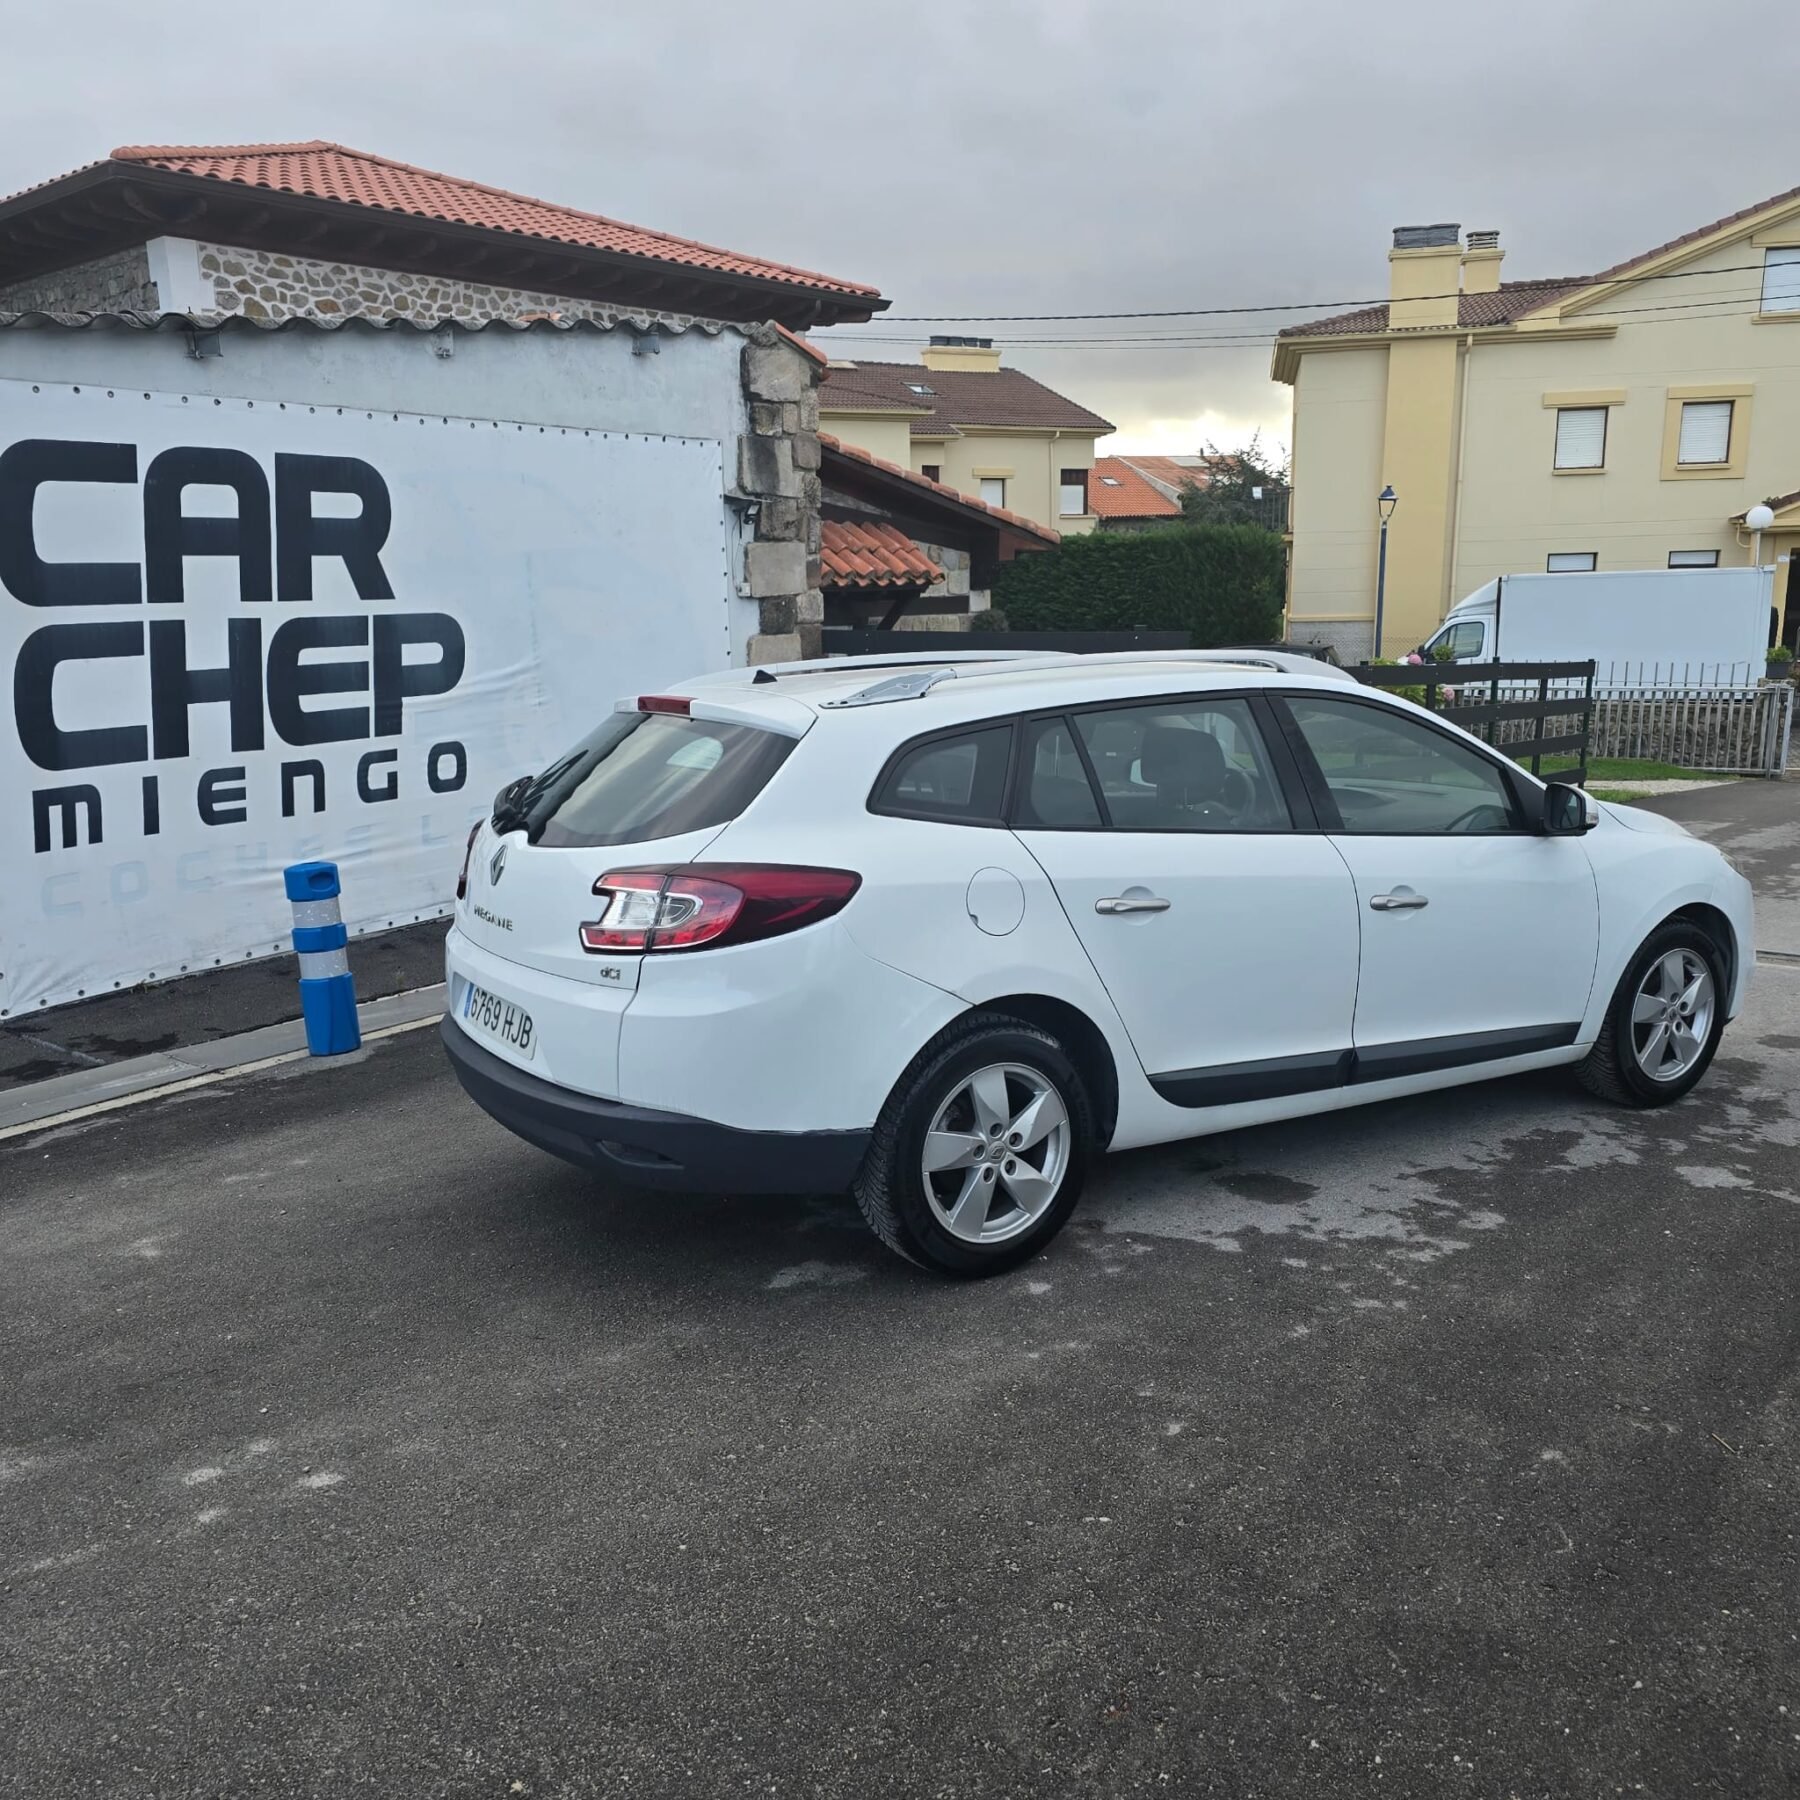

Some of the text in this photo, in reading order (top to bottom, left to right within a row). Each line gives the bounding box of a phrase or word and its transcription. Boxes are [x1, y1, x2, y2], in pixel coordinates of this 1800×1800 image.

[0, 439, 396, 607] CAR
[13, 612, 466, 771] CHEP
[471, 987, 533, 1049] 6769 HJB
